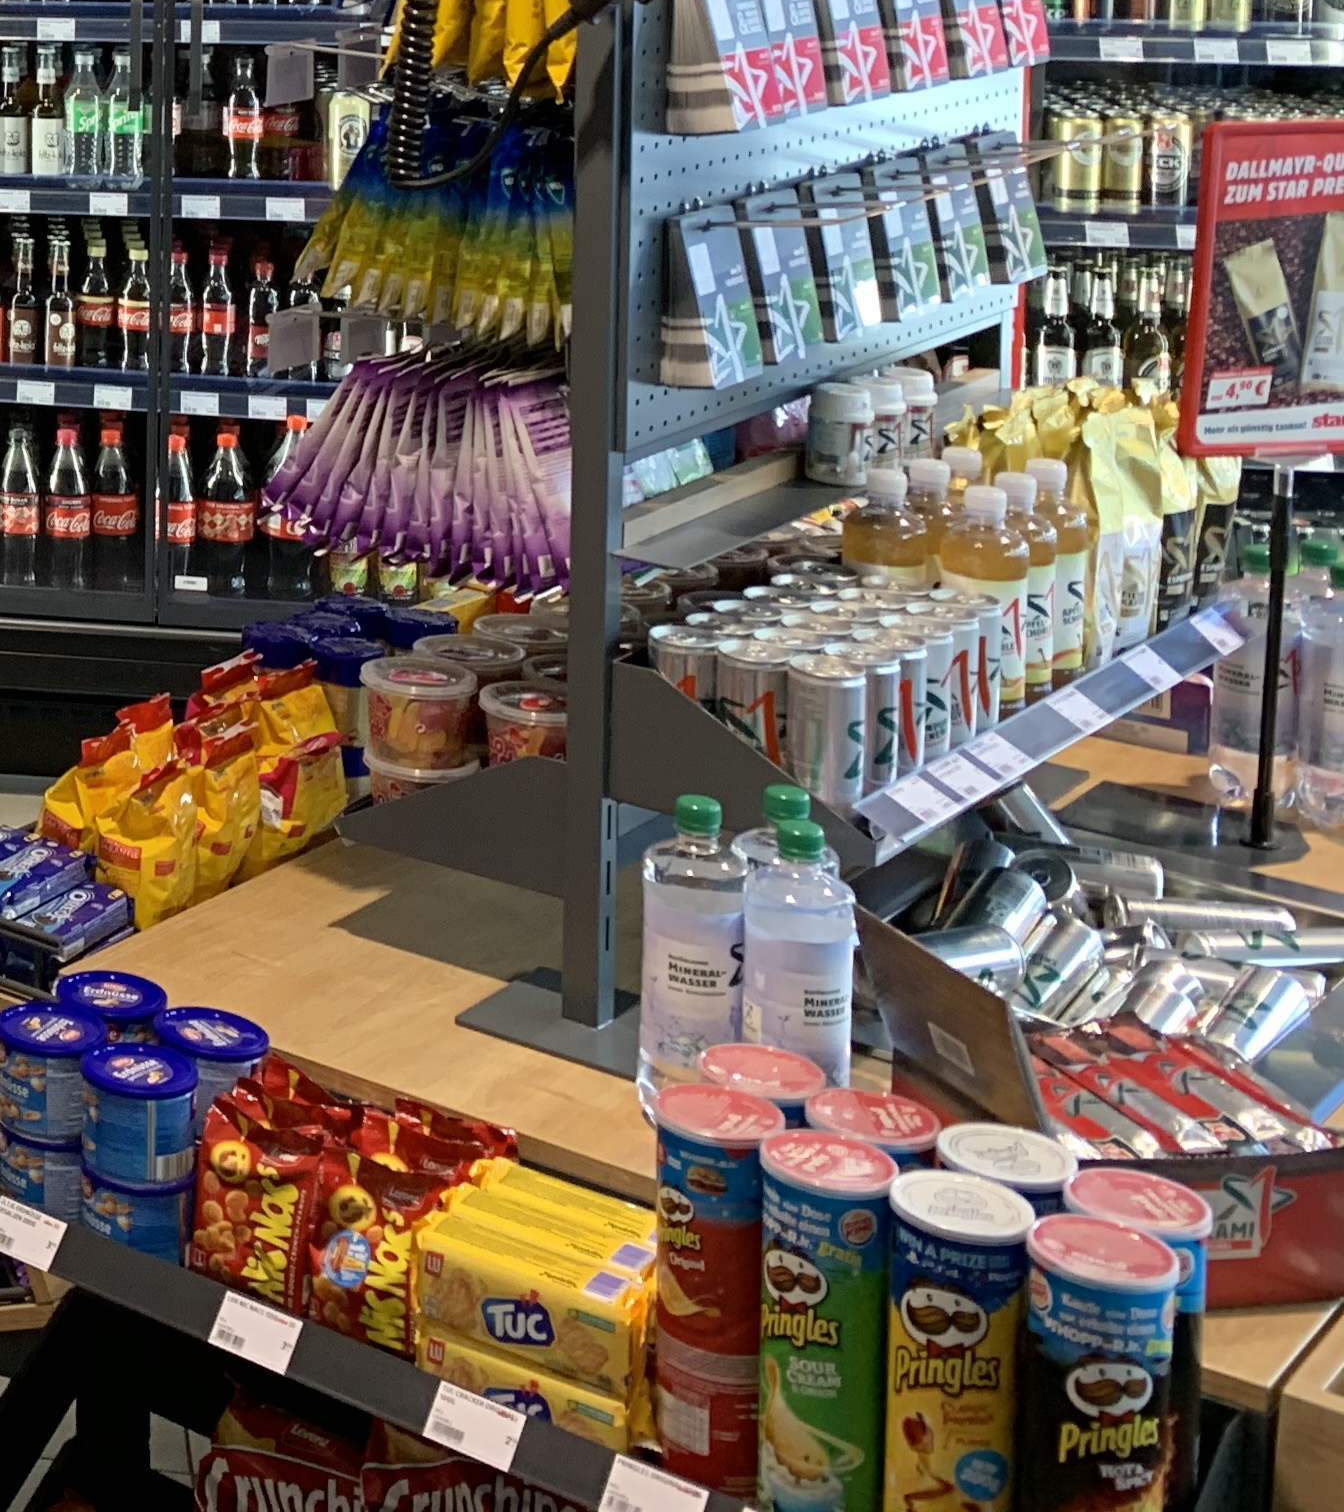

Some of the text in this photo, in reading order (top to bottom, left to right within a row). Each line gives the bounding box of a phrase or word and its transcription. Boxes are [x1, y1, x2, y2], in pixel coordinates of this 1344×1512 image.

[1225, 153, 1344, 182] DALLMAYR-QU
[1223, 177, 1344, 205] ZUM STAR PRE
[1204, 425, 1225, 435] Mehr
[1227, 424, 1239, 434] als
[45, 512, 91, 534] Coca-Cola
[92, 508, 138, 530] Coca-Cola
[668, 961, 727, 978] MINERAL-
[668, 973, 718, 988] WASSER
[803, 996, 848, 1008] MINERA
[1215, 1219, 1257, 1240] AMI
[817, 1241, 863, 1266] gratis
[940, 1247, 987, 1269] PRIZE
[486, 1303, 549, 1341] TUC
[761, 1303, 841, 1347] Pringles
[788, 1355, 836, 1373] SOUR
[894, 1345, 1000, 1397] Pringles
[786, 1369, 842, 1387] CREAM
[455, 1391, 486, 1407] CRACKER
[290, 1423, 332, 1449] Lorenz
[1057, 1413, 1161, 1465] Pringles
[202, 1456, 363, 1512] Crunchi
